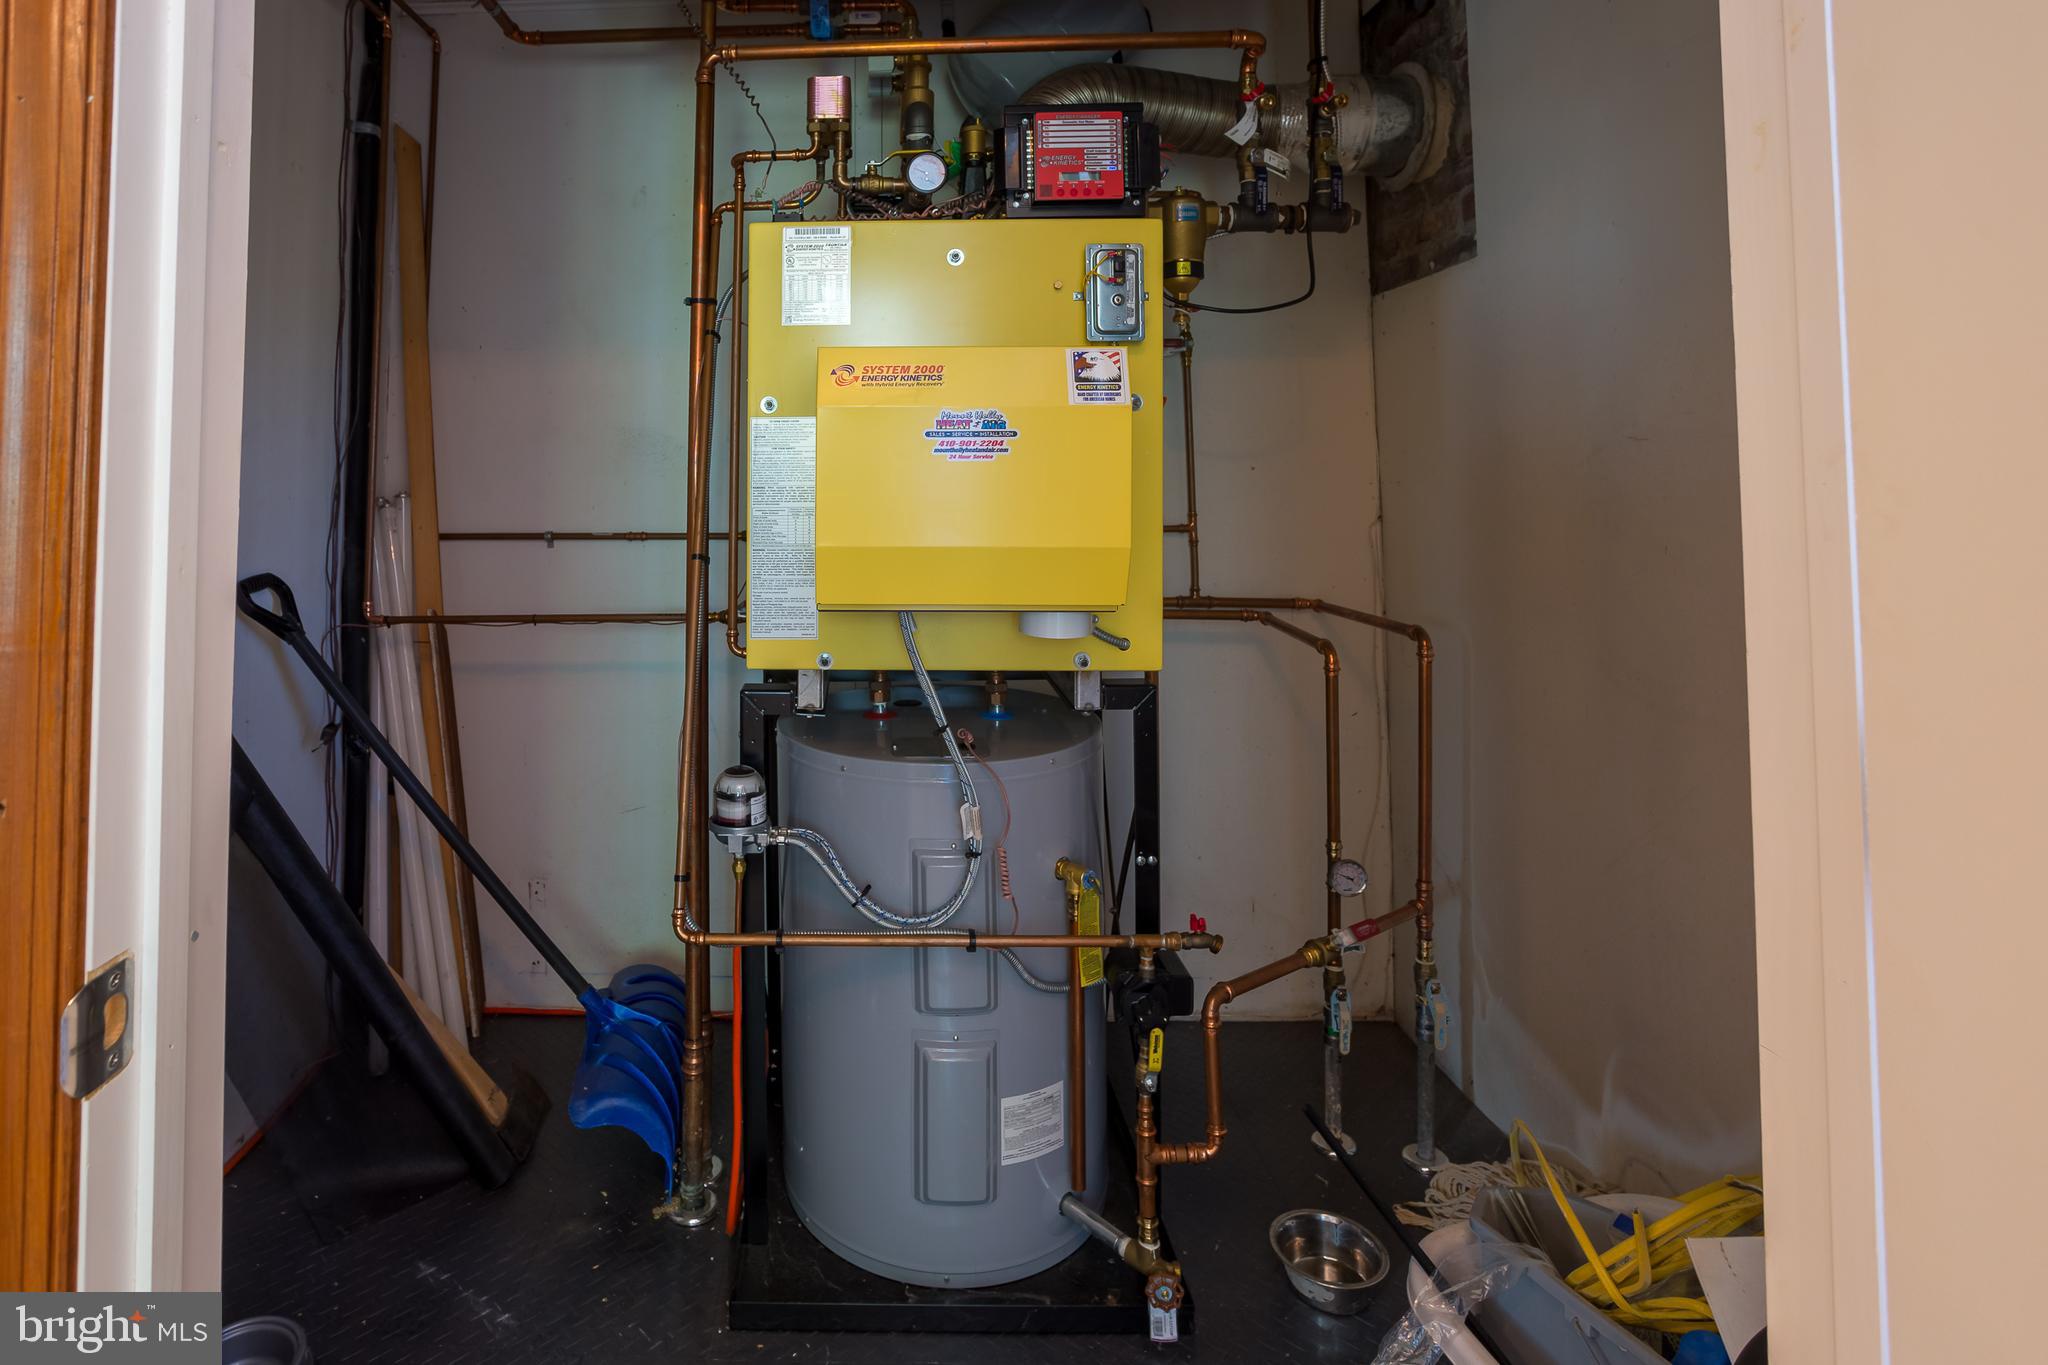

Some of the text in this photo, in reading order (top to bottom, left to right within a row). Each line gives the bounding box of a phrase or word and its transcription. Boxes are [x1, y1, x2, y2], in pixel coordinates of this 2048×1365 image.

[861, 365, 944, 375] SYSTEM 2000
[861, 374, 899, 382] ENERGY
[941, 410, 1003, 420] Mount Holly
[936, 419, 973, 429] HEAT
[981, 419, 1007, 429] AIR
